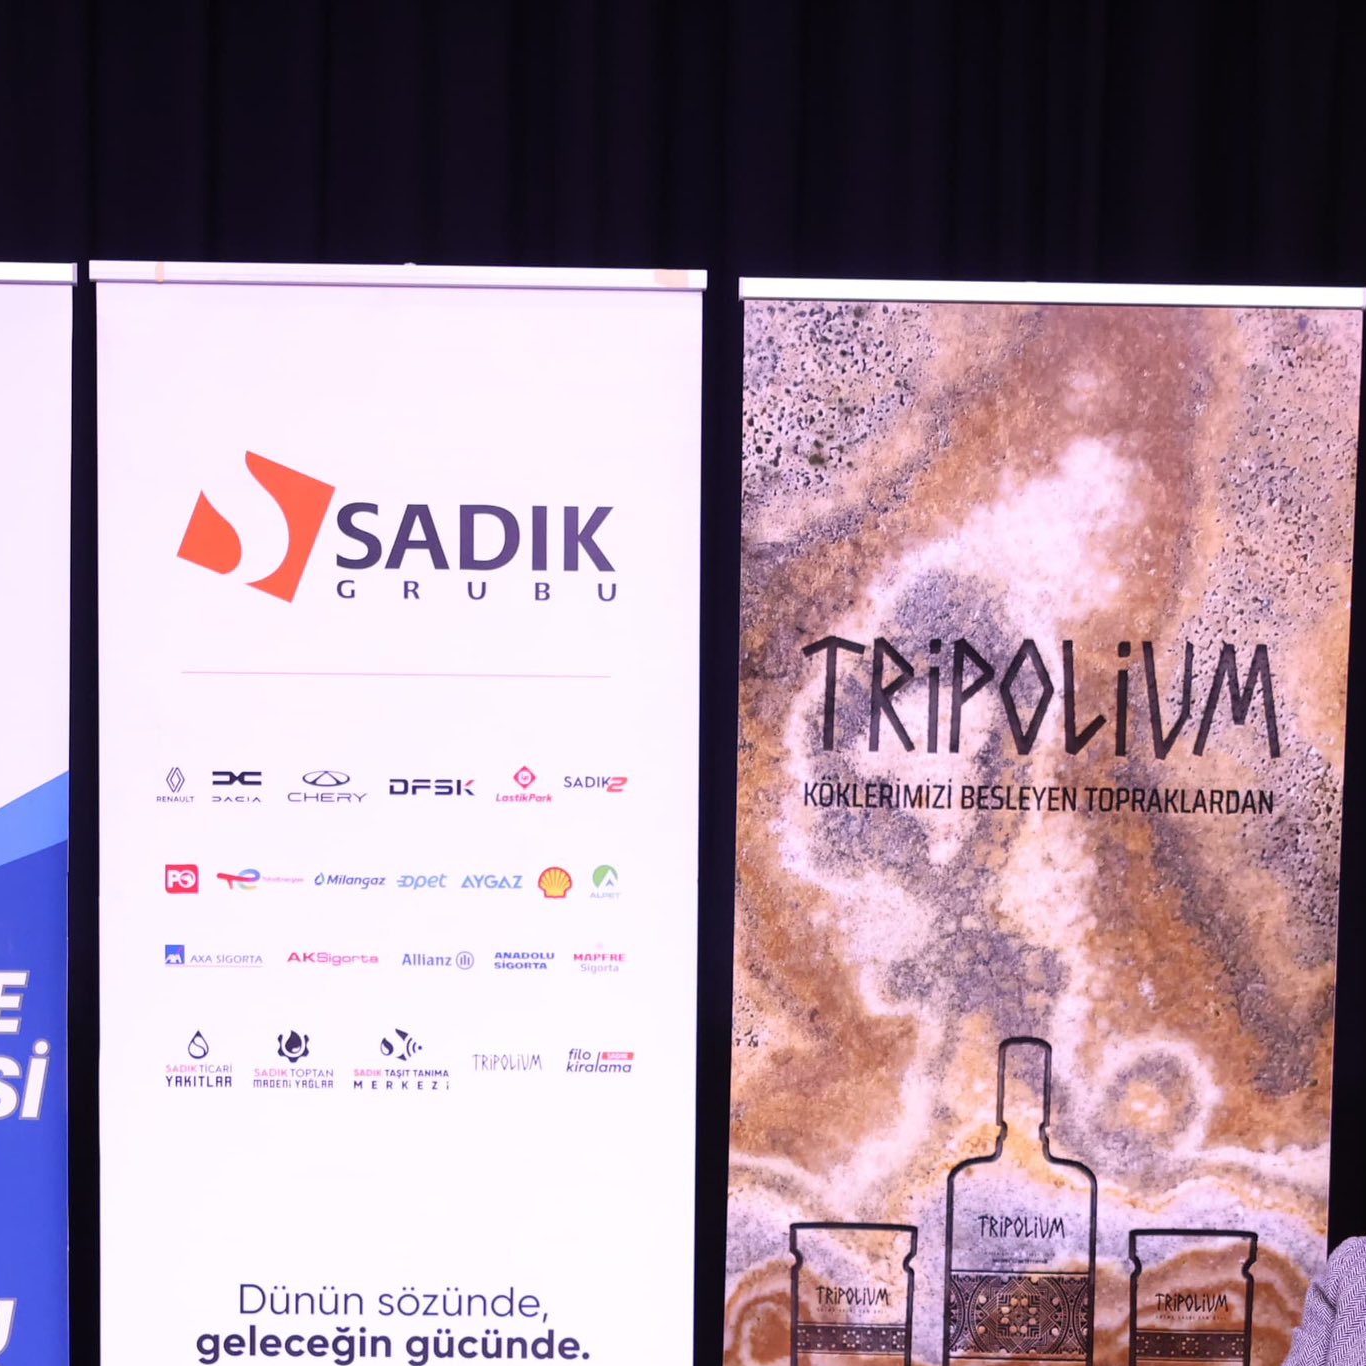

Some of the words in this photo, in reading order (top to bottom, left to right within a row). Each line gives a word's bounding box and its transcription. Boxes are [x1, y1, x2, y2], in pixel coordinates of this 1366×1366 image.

[336, 502, 616, 572] SADIK
[336, 580, 617, 602] GRUBU
[389, 779, 475, 796] DFSK
[288, 792, 368, 803] CHERY
[803, 777, 953, 809] KÖKLERİMİZİ
[962, 784, 1077, 812] BESLEYEN
[1084, 787, 1274, 815] TOPRAKLARDAN
[327, 873, 386, 890] Milangaz
[461, 875, 523, 889] AYGAZ
[190, 955, 213, 964] AXA
[402, 953, 452, 966] Allianz
[494, 952, 555, 960] ANADOLU
[568, 1048, 592, 1060] filo
[566, 1051, 632, 1073] kiralama
[166, 1065, 197, 1073] SADIK
[254, 1069, 288, 1077] SADIK
[290, 1069, 334, 1078] TOPTAN
[354, 1069, 382, 1077] SADIK
[385, 1069, 410, 1079] TAŞIT
[413, 1069, 449, 1078] TANIMA
[165, 1076, 233, 1088] YAKITLAR
[239, 1284, 364, 1316] Dünün
[378, 1286, 549, 1323] sözünde,
[196, 1325, 392, 1366] geleceğin
[405, 1328, 590, 1366] gücünde.
